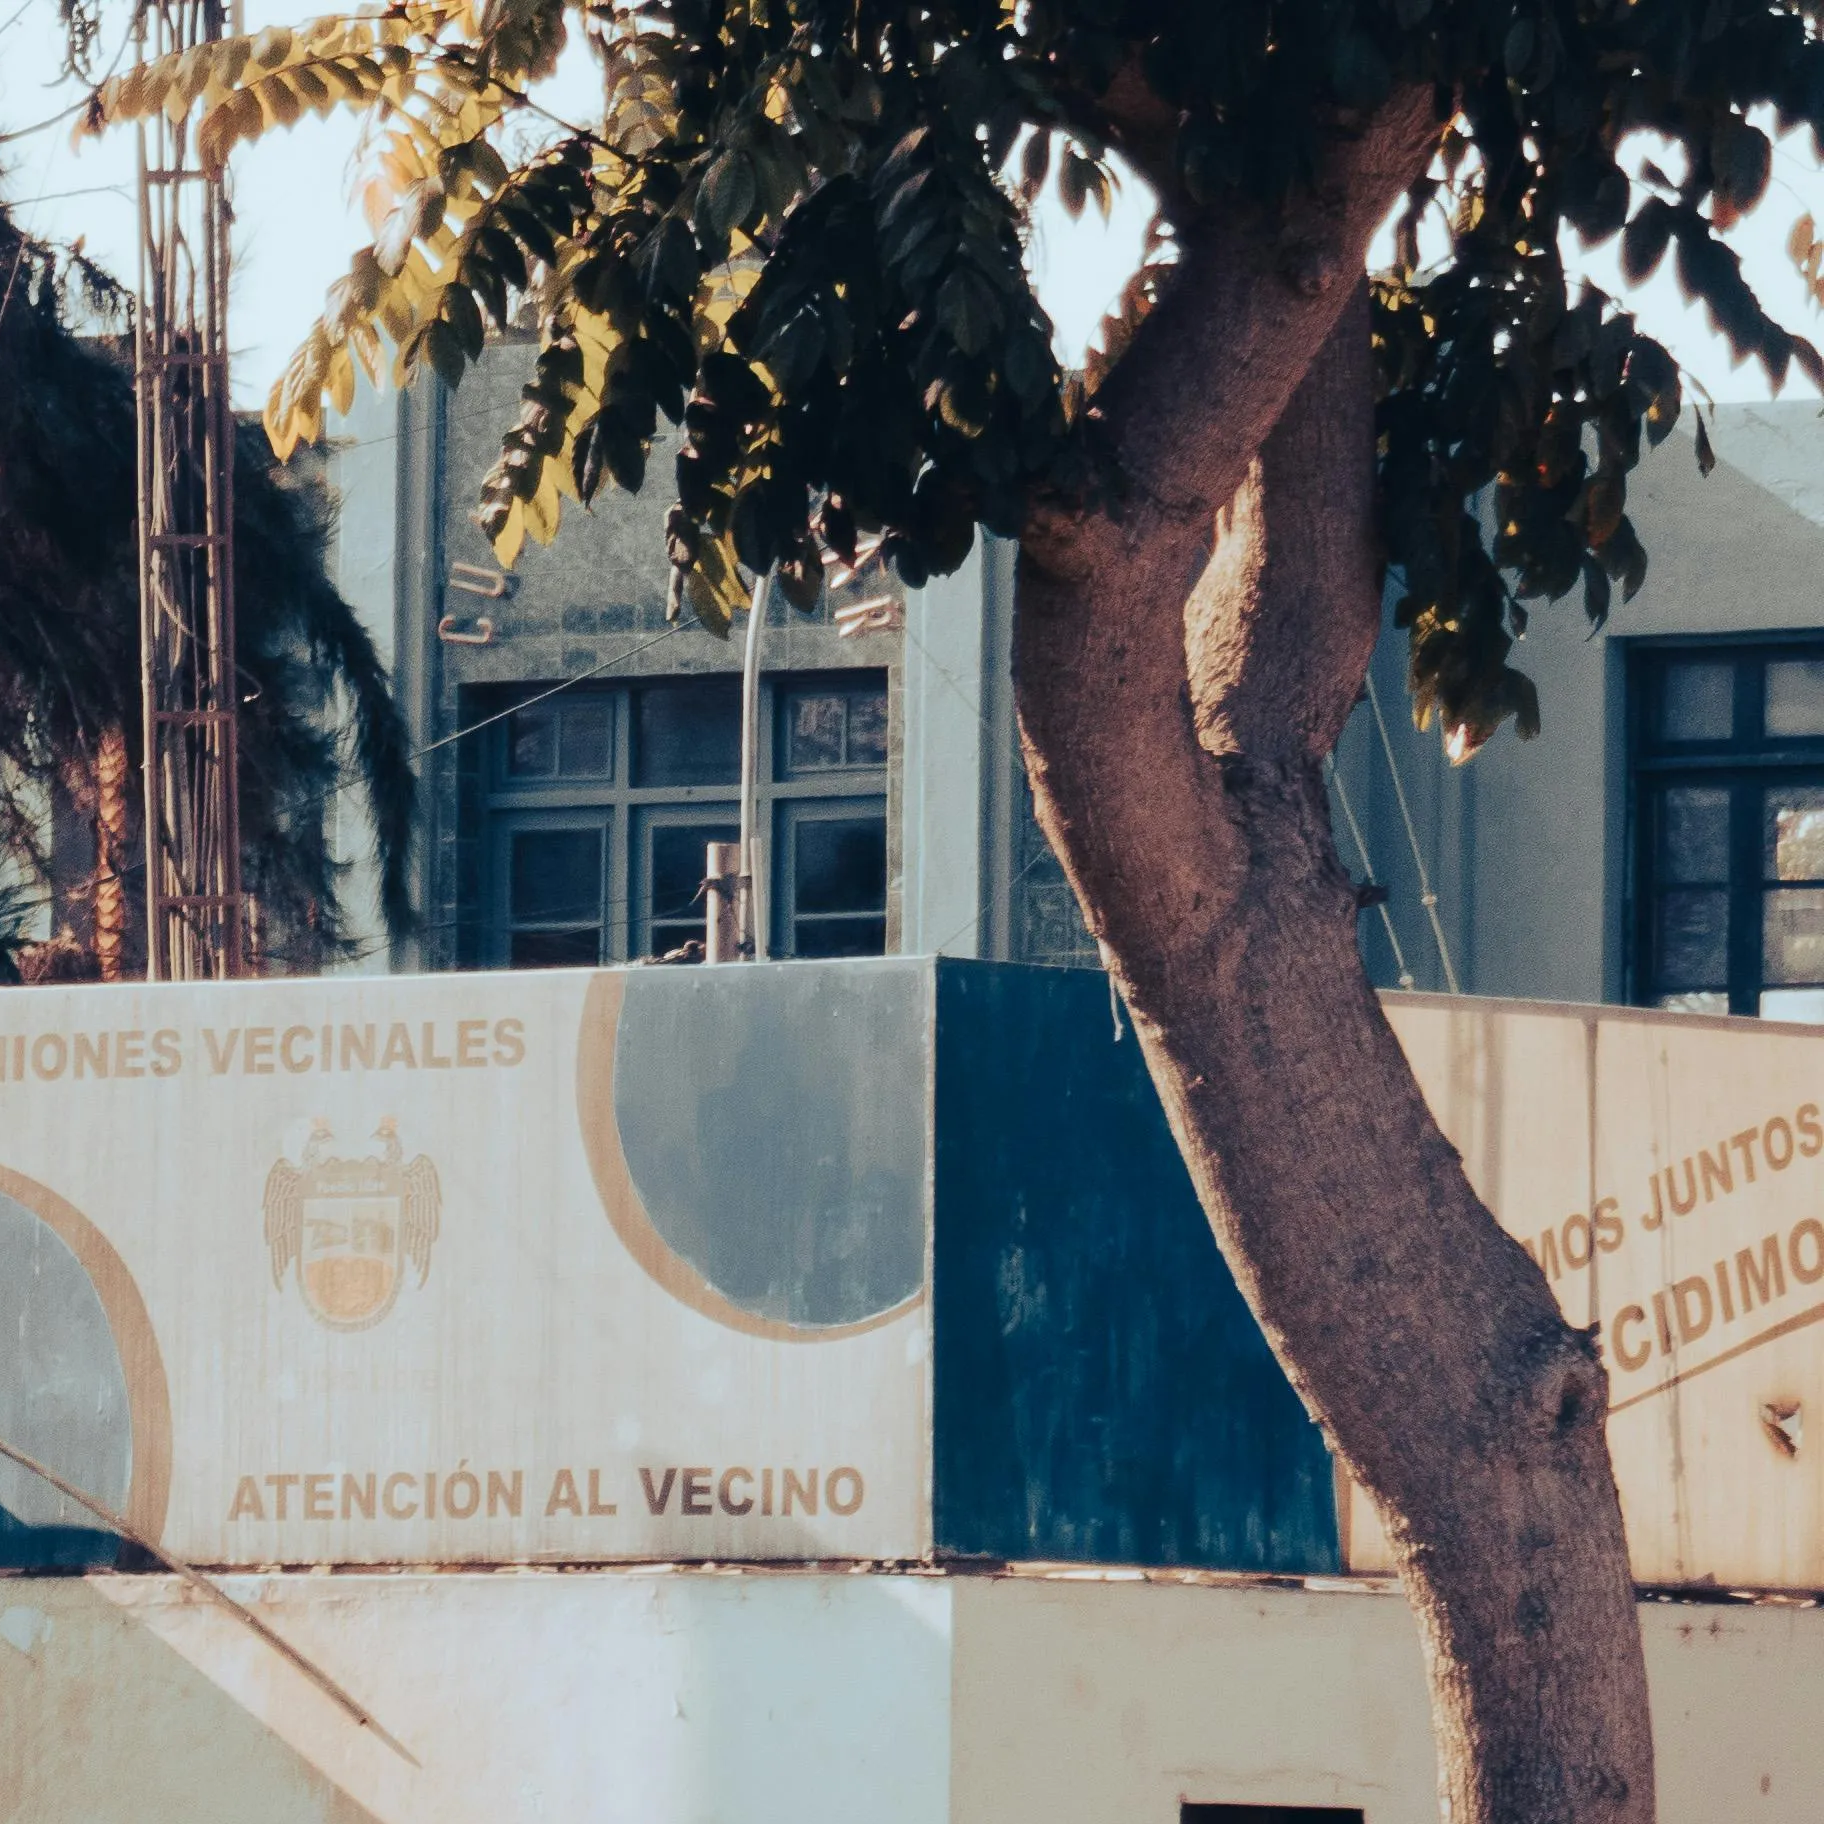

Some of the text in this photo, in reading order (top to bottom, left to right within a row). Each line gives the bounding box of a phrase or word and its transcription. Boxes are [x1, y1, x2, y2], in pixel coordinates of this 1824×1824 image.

[201, 1017, 527, 1076] VECINALES
[1522, 1101, 1824, 1283] MOS JUNTOS
[1597, 1216, 1824, 1374] CIDIMO
[225, 1458, 866, 1522] ATENCIÓN AL VECINO
